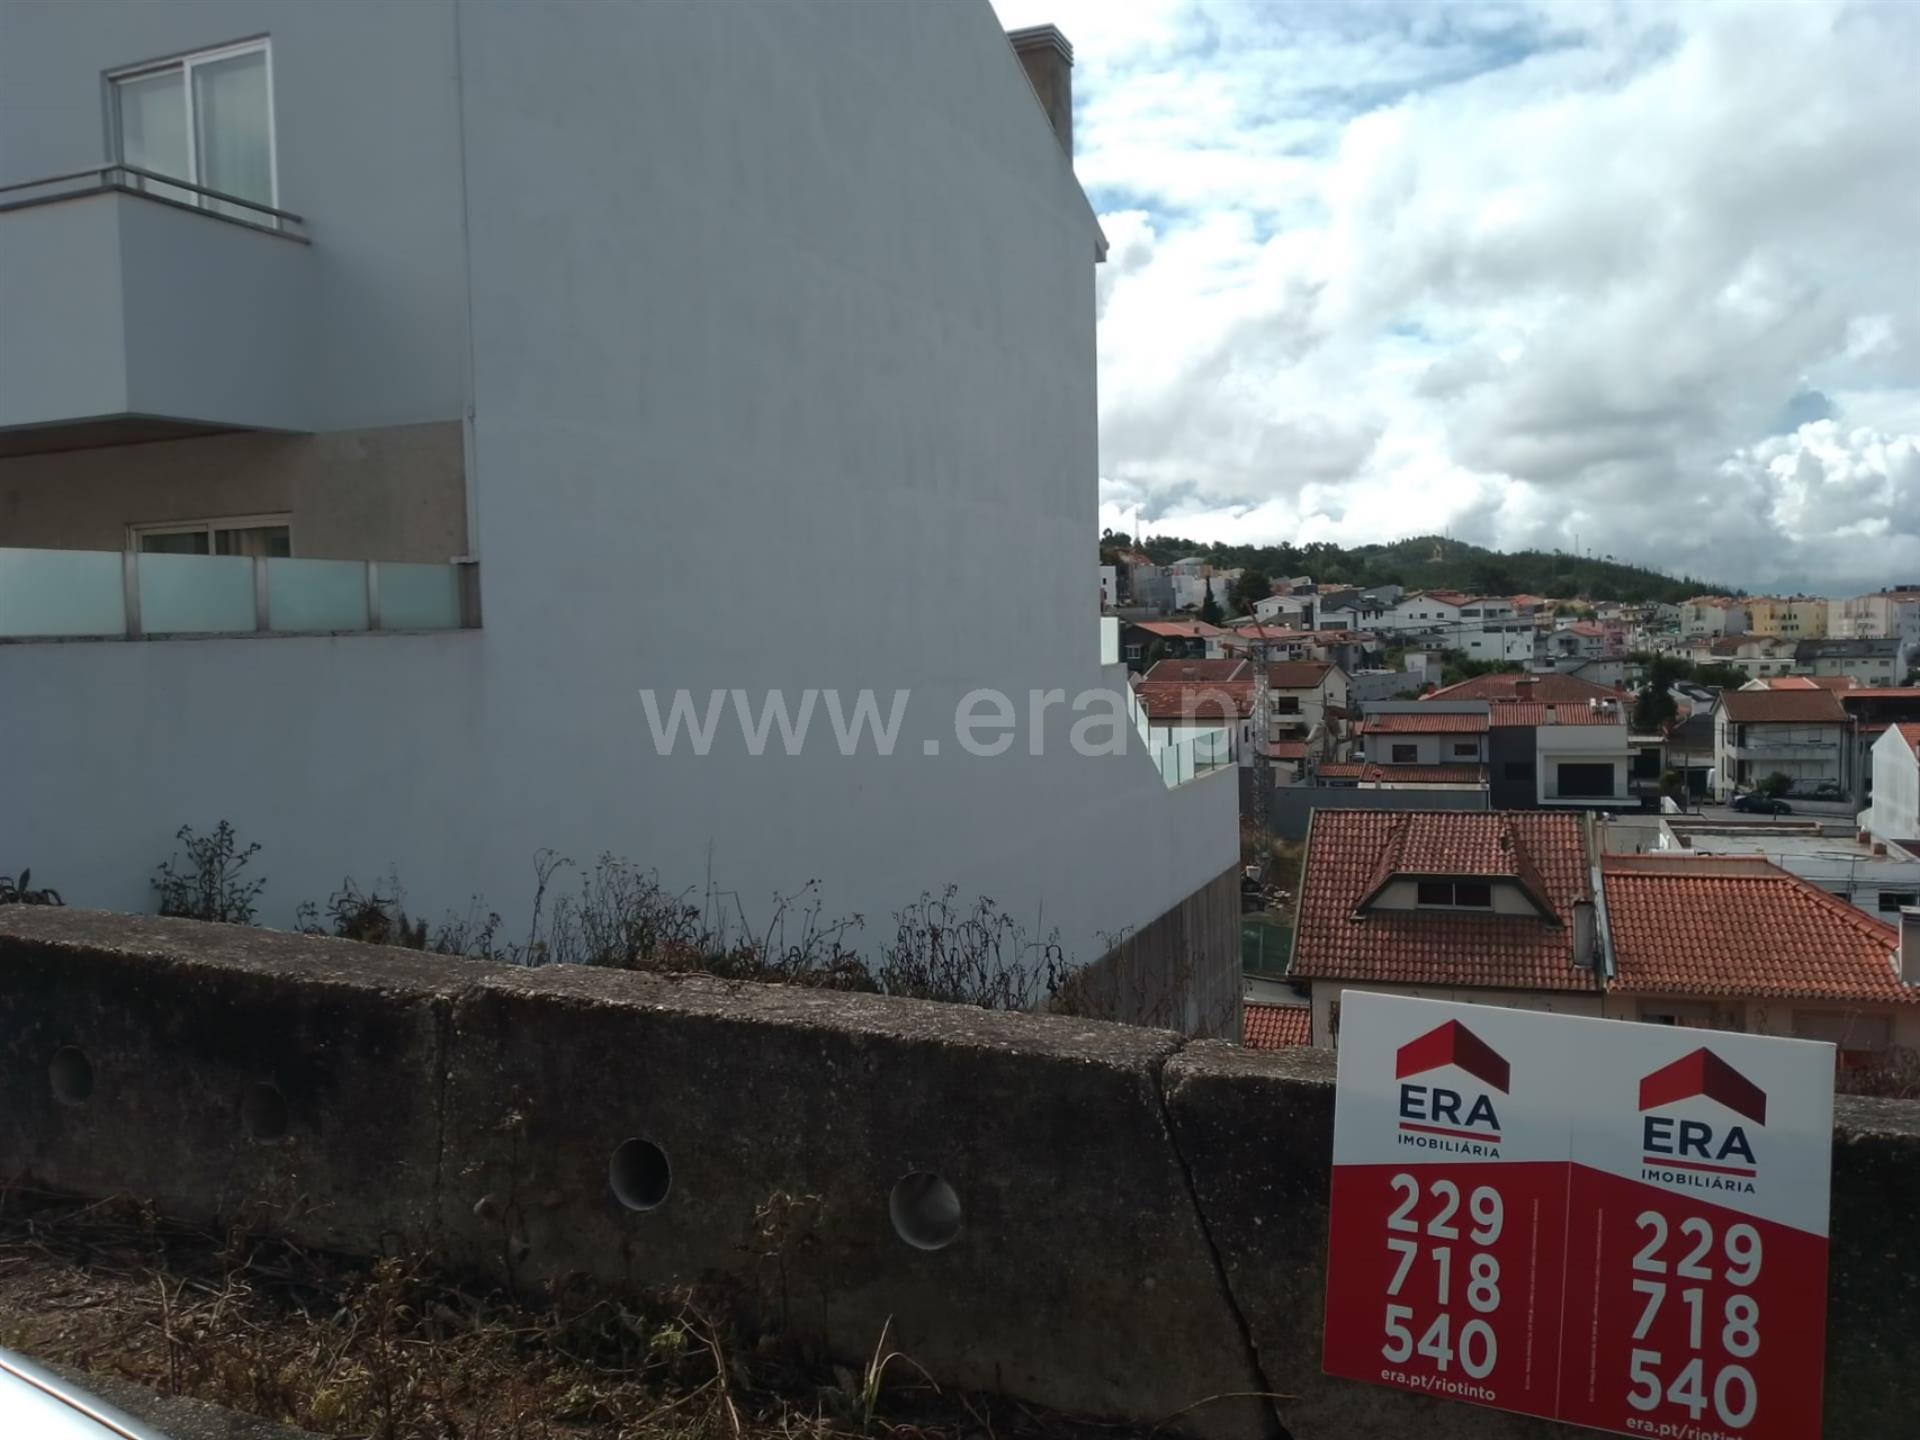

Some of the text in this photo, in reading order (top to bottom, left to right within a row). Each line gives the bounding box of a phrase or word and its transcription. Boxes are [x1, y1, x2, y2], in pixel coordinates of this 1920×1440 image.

[1400, 1084, 1501, 1131] ERA
[1642, 1115, 1757, 1164] ERA
[1398, 1133, 1501, 1159] IMOBILIÁRIA
[1641, 1168, 1756, 1195] IMOBILIÁRIA
[1387, 1173, 1504, 1246] 229
[1386, 1237, 1501, 1313] 718
[1632, 1210, 1763, 1287] 229
[1381, 1303, 1498, 1379] 540
[1631, 1278, 1760, 1358] 718
[1381, 1369, 1496, 1401] era.pt/riotinto
[1626, 1348, 1758, 1429] 540
